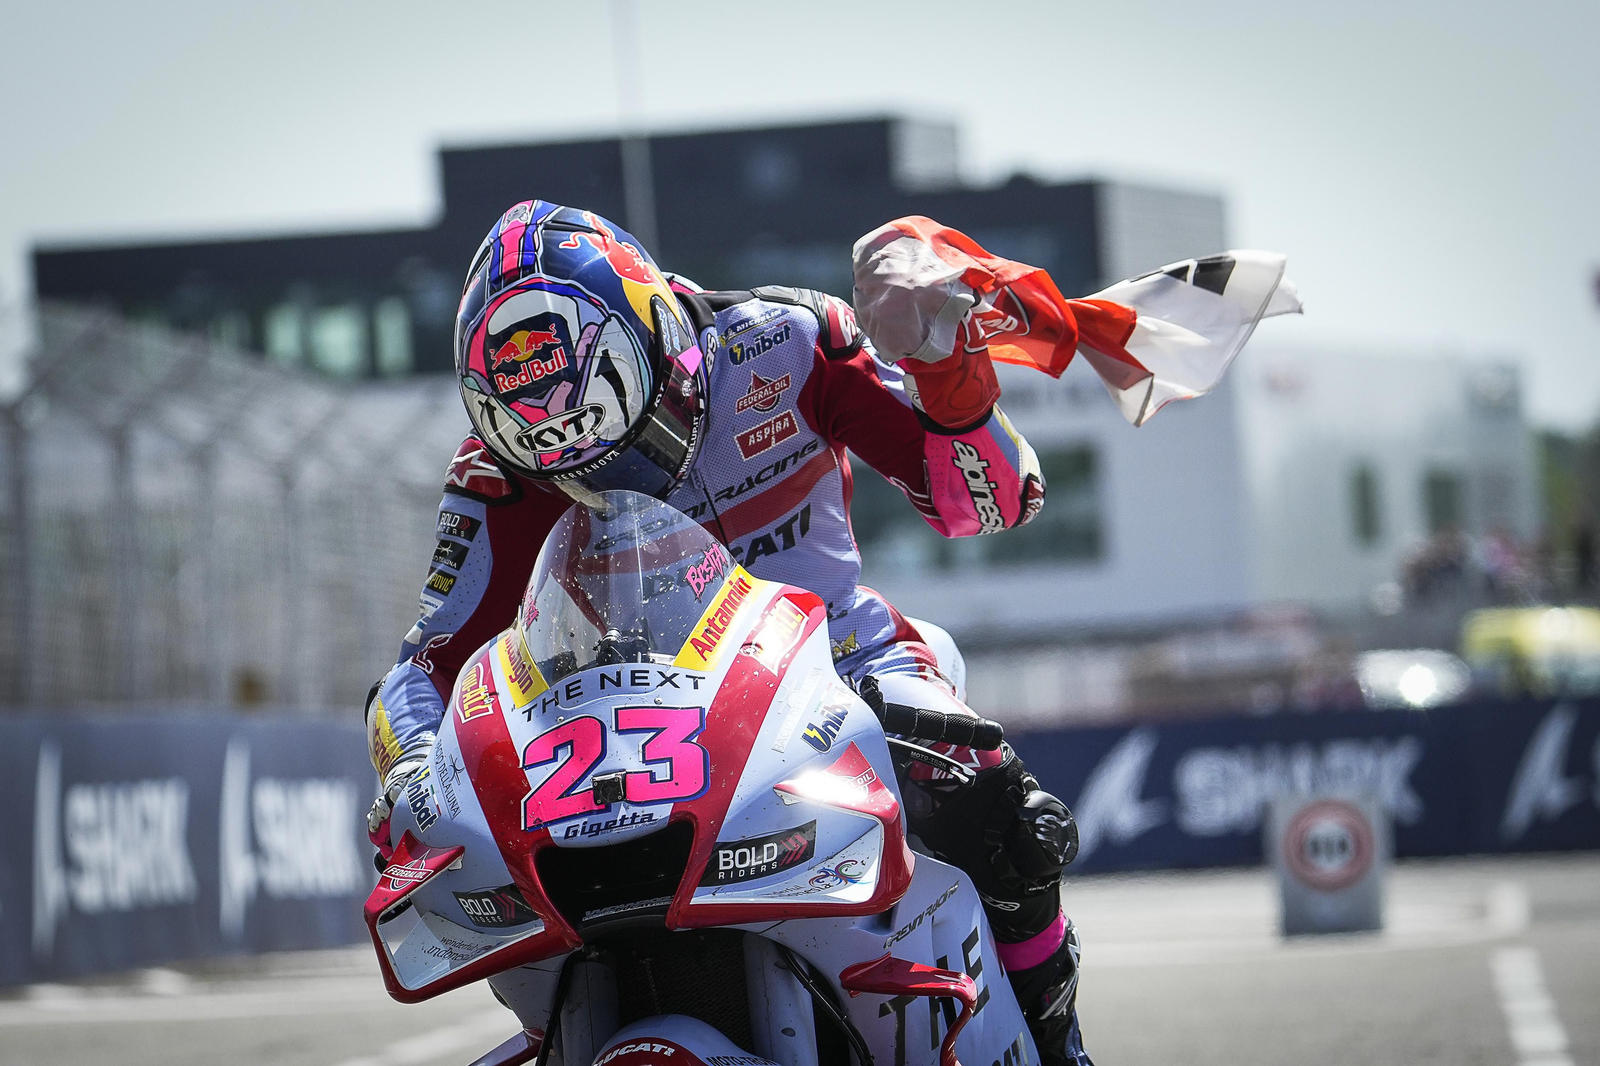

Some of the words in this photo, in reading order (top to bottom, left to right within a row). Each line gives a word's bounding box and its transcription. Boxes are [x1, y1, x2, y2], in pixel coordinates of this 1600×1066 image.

[728, 322, 792, 366] Unibat
[495, 362, 531, 394] Red
[530, 347, 568, 378] Bull
[738, 389, 773, 410] FEDERAL
[774, 378, 788, 391] OIL
[522, 409, 593, 451] KYT
[749, 416, 790, 448] ASPIRA
[553, 451, 620, 482] TERRANOVA
[714, 438, 819, 503] RACING
[440, 512, 461, 528] BOLD
[521, 678, 584, 722] THE
[600, 668, 706, 690] NEXT
[520, 704, 711, 833] 23
[856, 775, 872, 786] OIL
[407, 766, 438, 832] Unibat
[564, 812, 659, 840] Gigetta
[387, 867, 416, 878] FEDERAL
[718, 842, 778, 871] BOLD
[718, 862, 777, 880] RIDERS
[459, 898, 496, 915] BOLD
